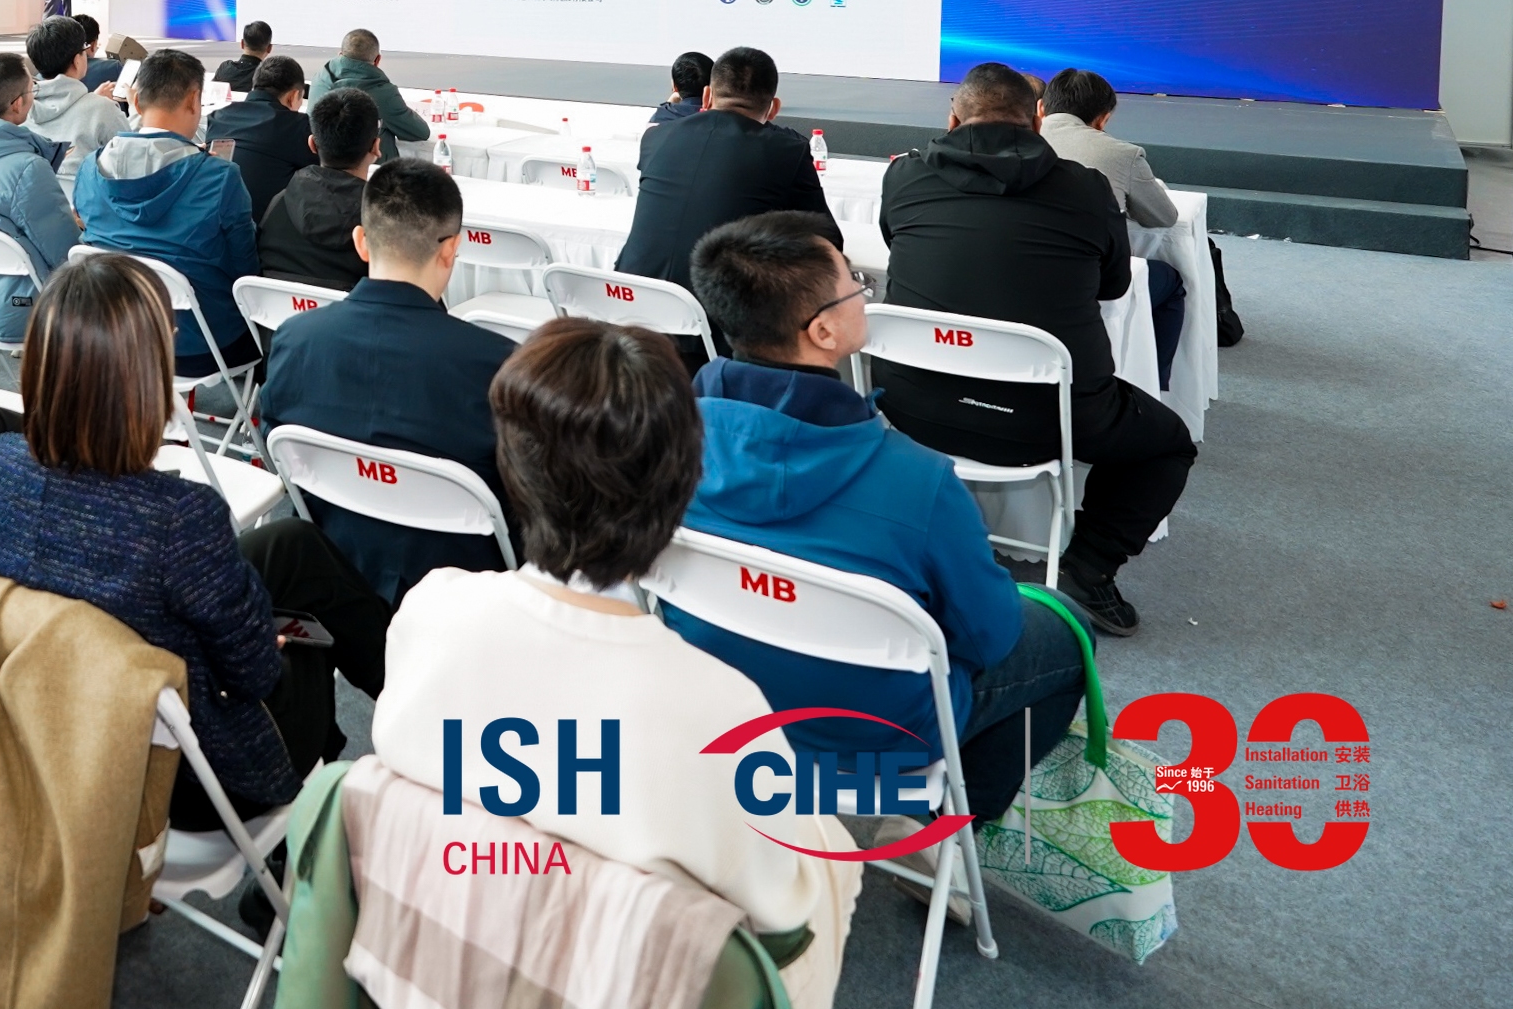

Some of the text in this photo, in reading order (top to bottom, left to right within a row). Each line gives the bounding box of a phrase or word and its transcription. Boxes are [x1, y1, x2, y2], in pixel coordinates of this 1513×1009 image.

[467, 230, 491, 245] MB
[605, 283, 635, 302] MB
[934, 327, 975, 348] MB
[355, 456, 398, 485] MB
[739, 565, 798, 604] MB
